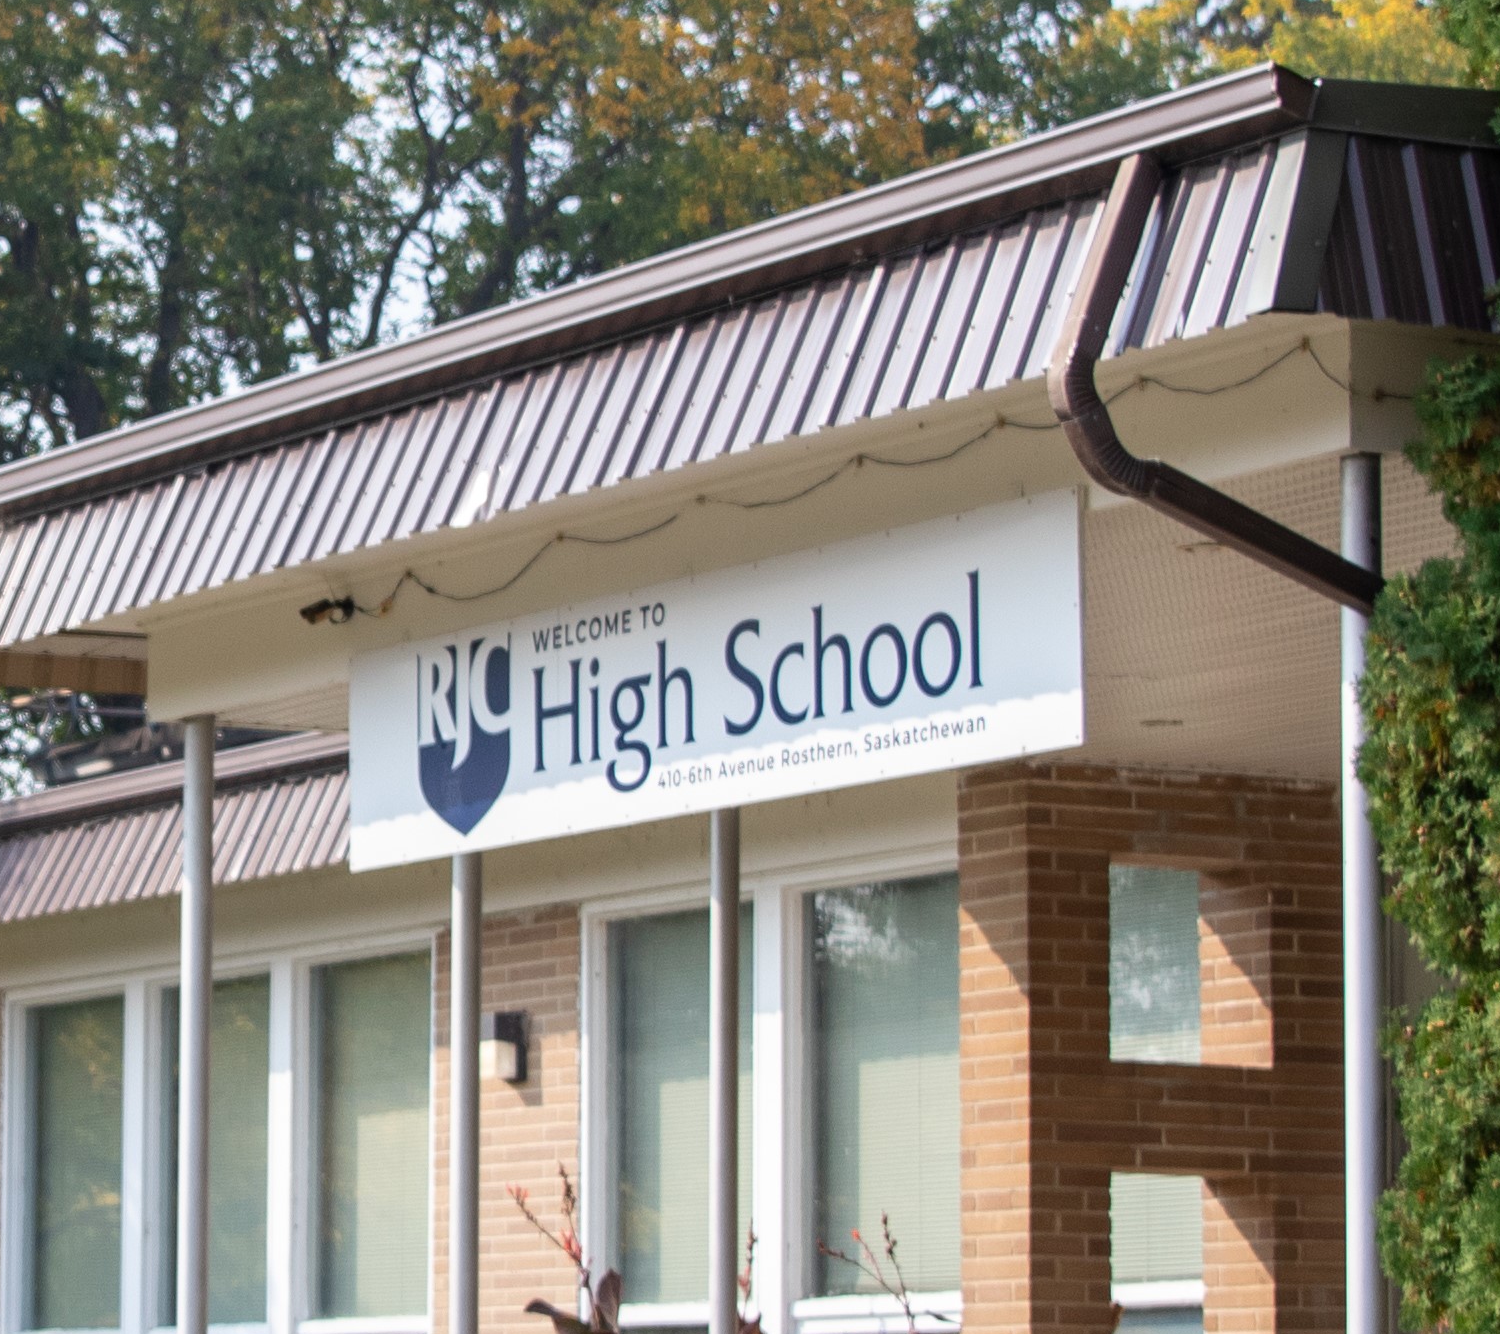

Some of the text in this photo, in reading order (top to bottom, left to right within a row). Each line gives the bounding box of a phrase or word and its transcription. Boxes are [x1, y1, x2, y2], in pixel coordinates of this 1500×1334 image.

[533, 602, 666, 653] WELCOME TO
[417, 634, 511, 771] RJC
[532, 568, 983, 793] High School
[657, 716, 986, 789] 410-6th Avenue Rosthern, Saskatchewan
